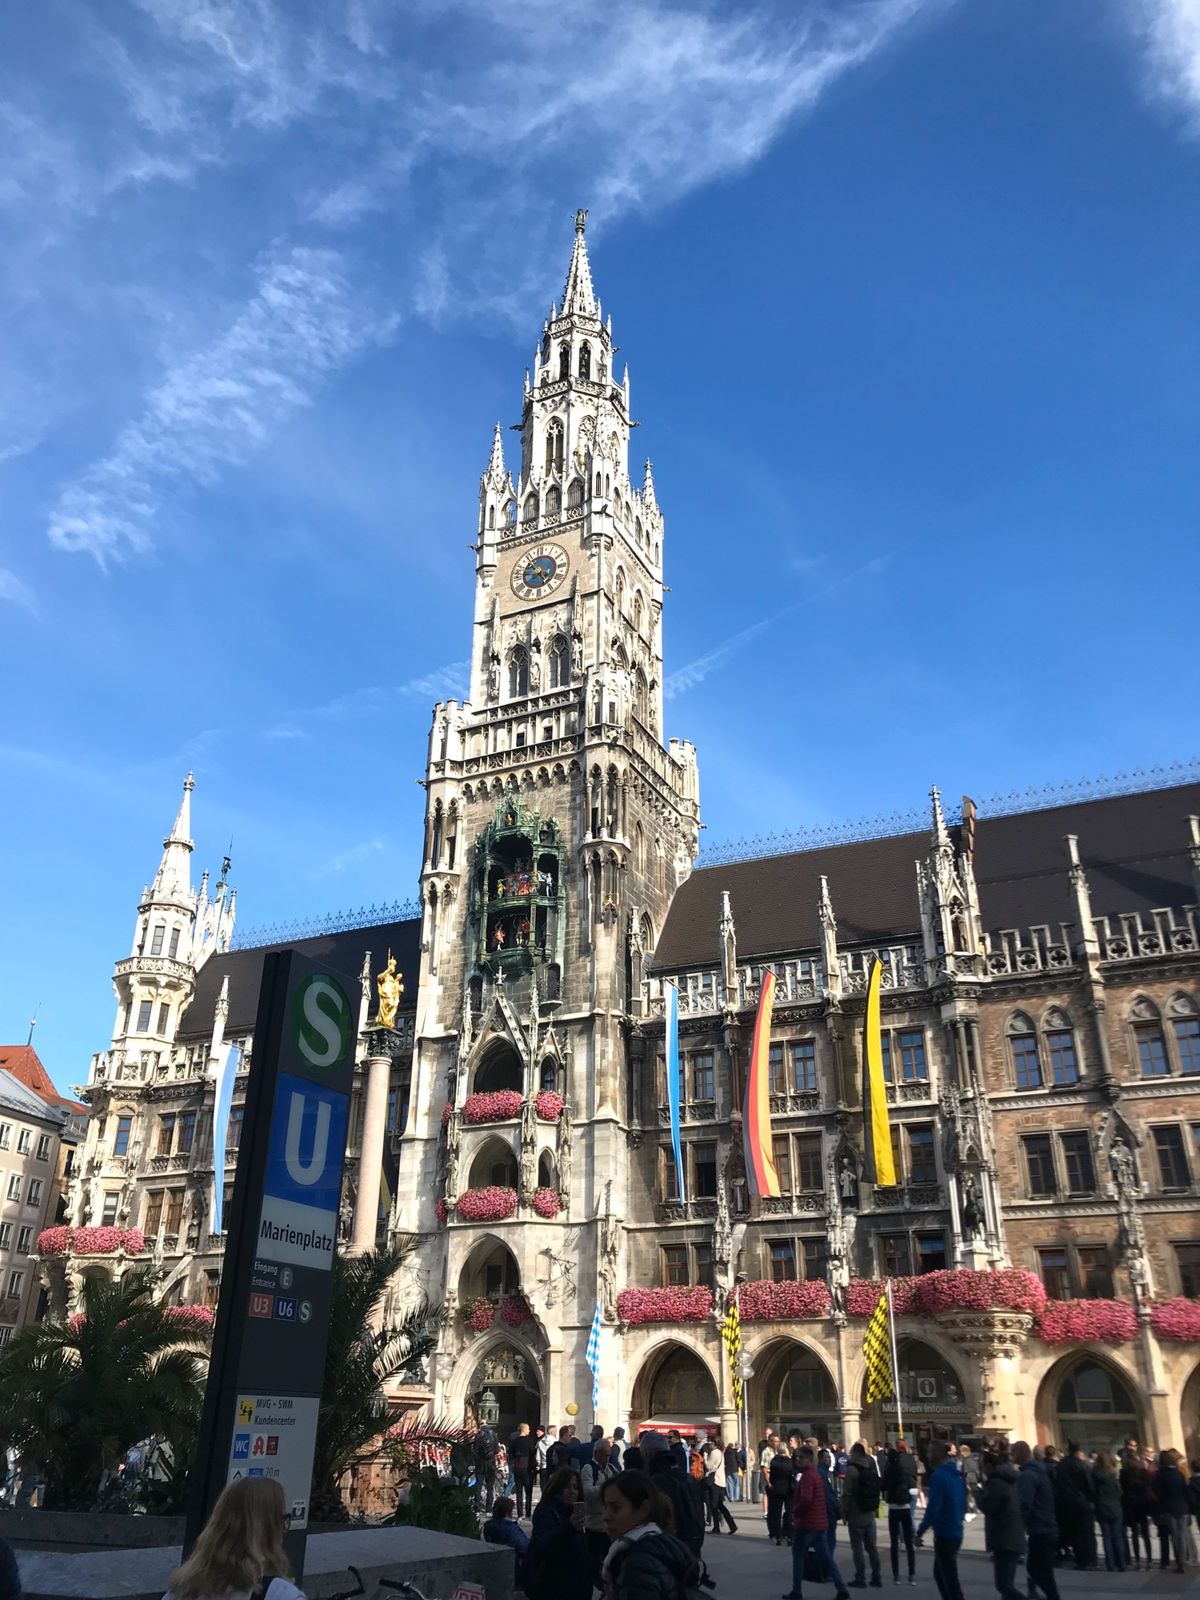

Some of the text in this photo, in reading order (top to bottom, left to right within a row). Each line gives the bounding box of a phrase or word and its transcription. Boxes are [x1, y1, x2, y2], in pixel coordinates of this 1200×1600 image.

[299, 981, 343, 1067] S
[285, 1092, 332, 1186] U
[260, 1220, 332, 1252] Marienplatz
[254, 1261, 278, 1276] Eingang
[252, 1276, 276, 1289] Entrance
[253, 1297, 310, 1321] U3 U6 S
[256, 1399, 293, 1410] MVG SWM
[881, 1402, 973, 1414] Müchen Informatio
[254, 1416, 296, 1426] Kundencenter
[235, 1440, 249, 1452] WC
